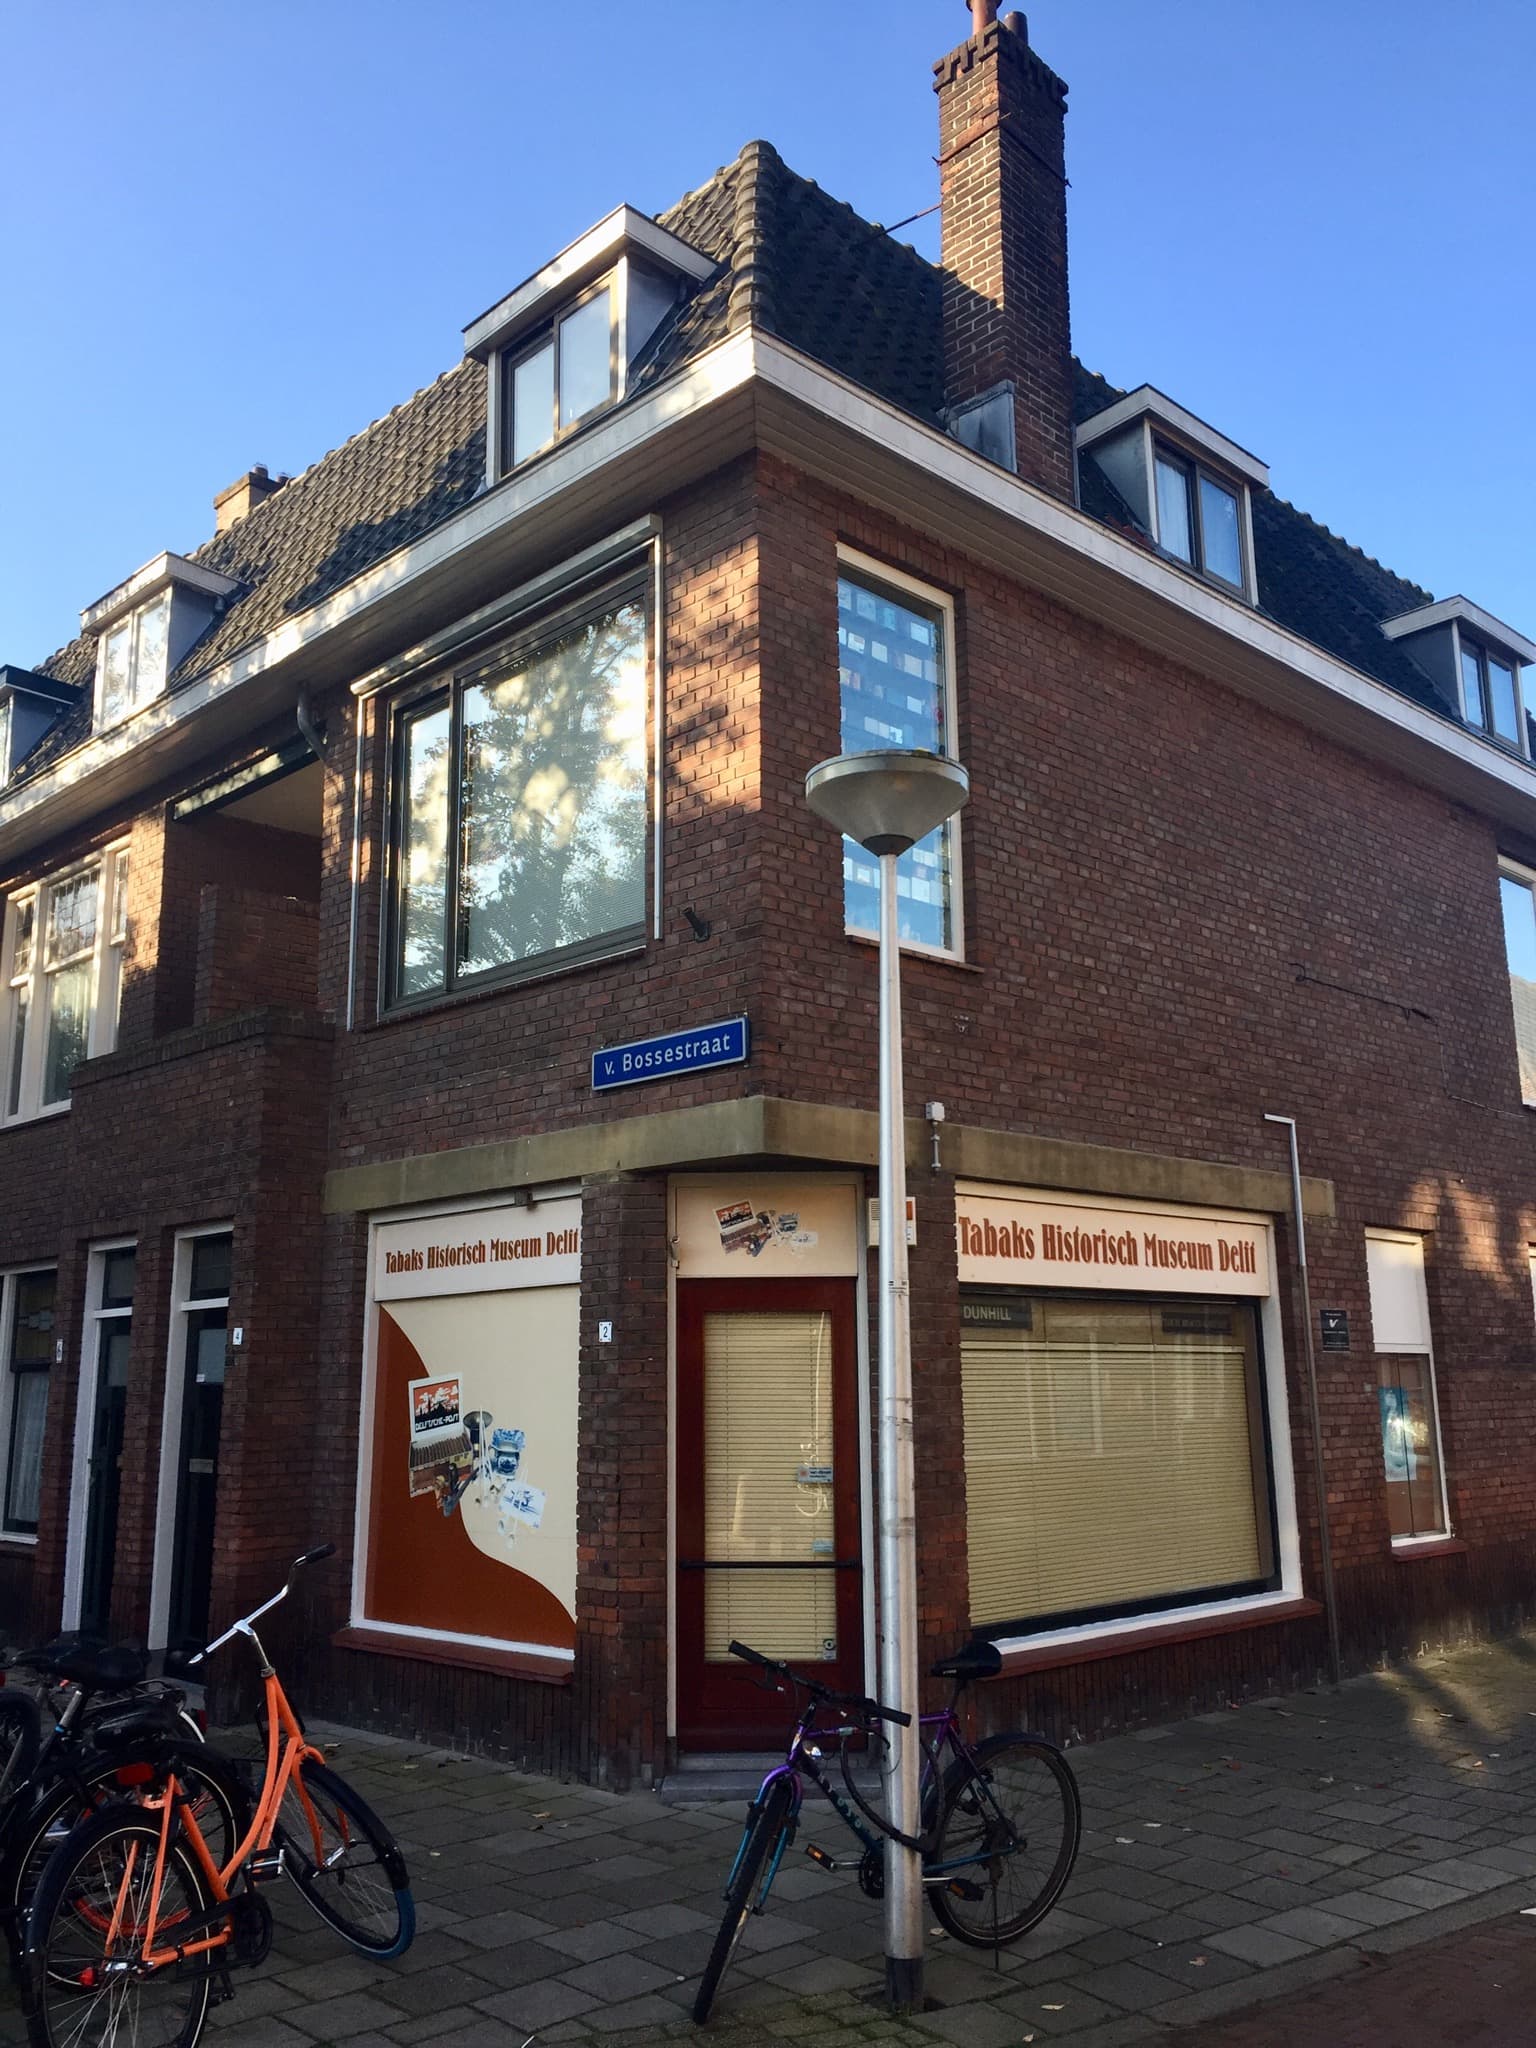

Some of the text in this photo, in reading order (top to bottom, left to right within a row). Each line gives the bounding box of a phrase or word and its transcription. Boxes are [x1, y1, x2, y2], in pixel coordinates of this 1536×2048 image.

[604, 1033, 731, 1076] v. Bossestraat
[386, 1228, 579, 1274] Tabaks Historisch Museum Delft
[958, 1216, 1257, 1274] Tabaks Historisch Museum Delft
[602, 1325, 609, 1338] 2
[962, 1305, 1012, 1321] DUNHILL
